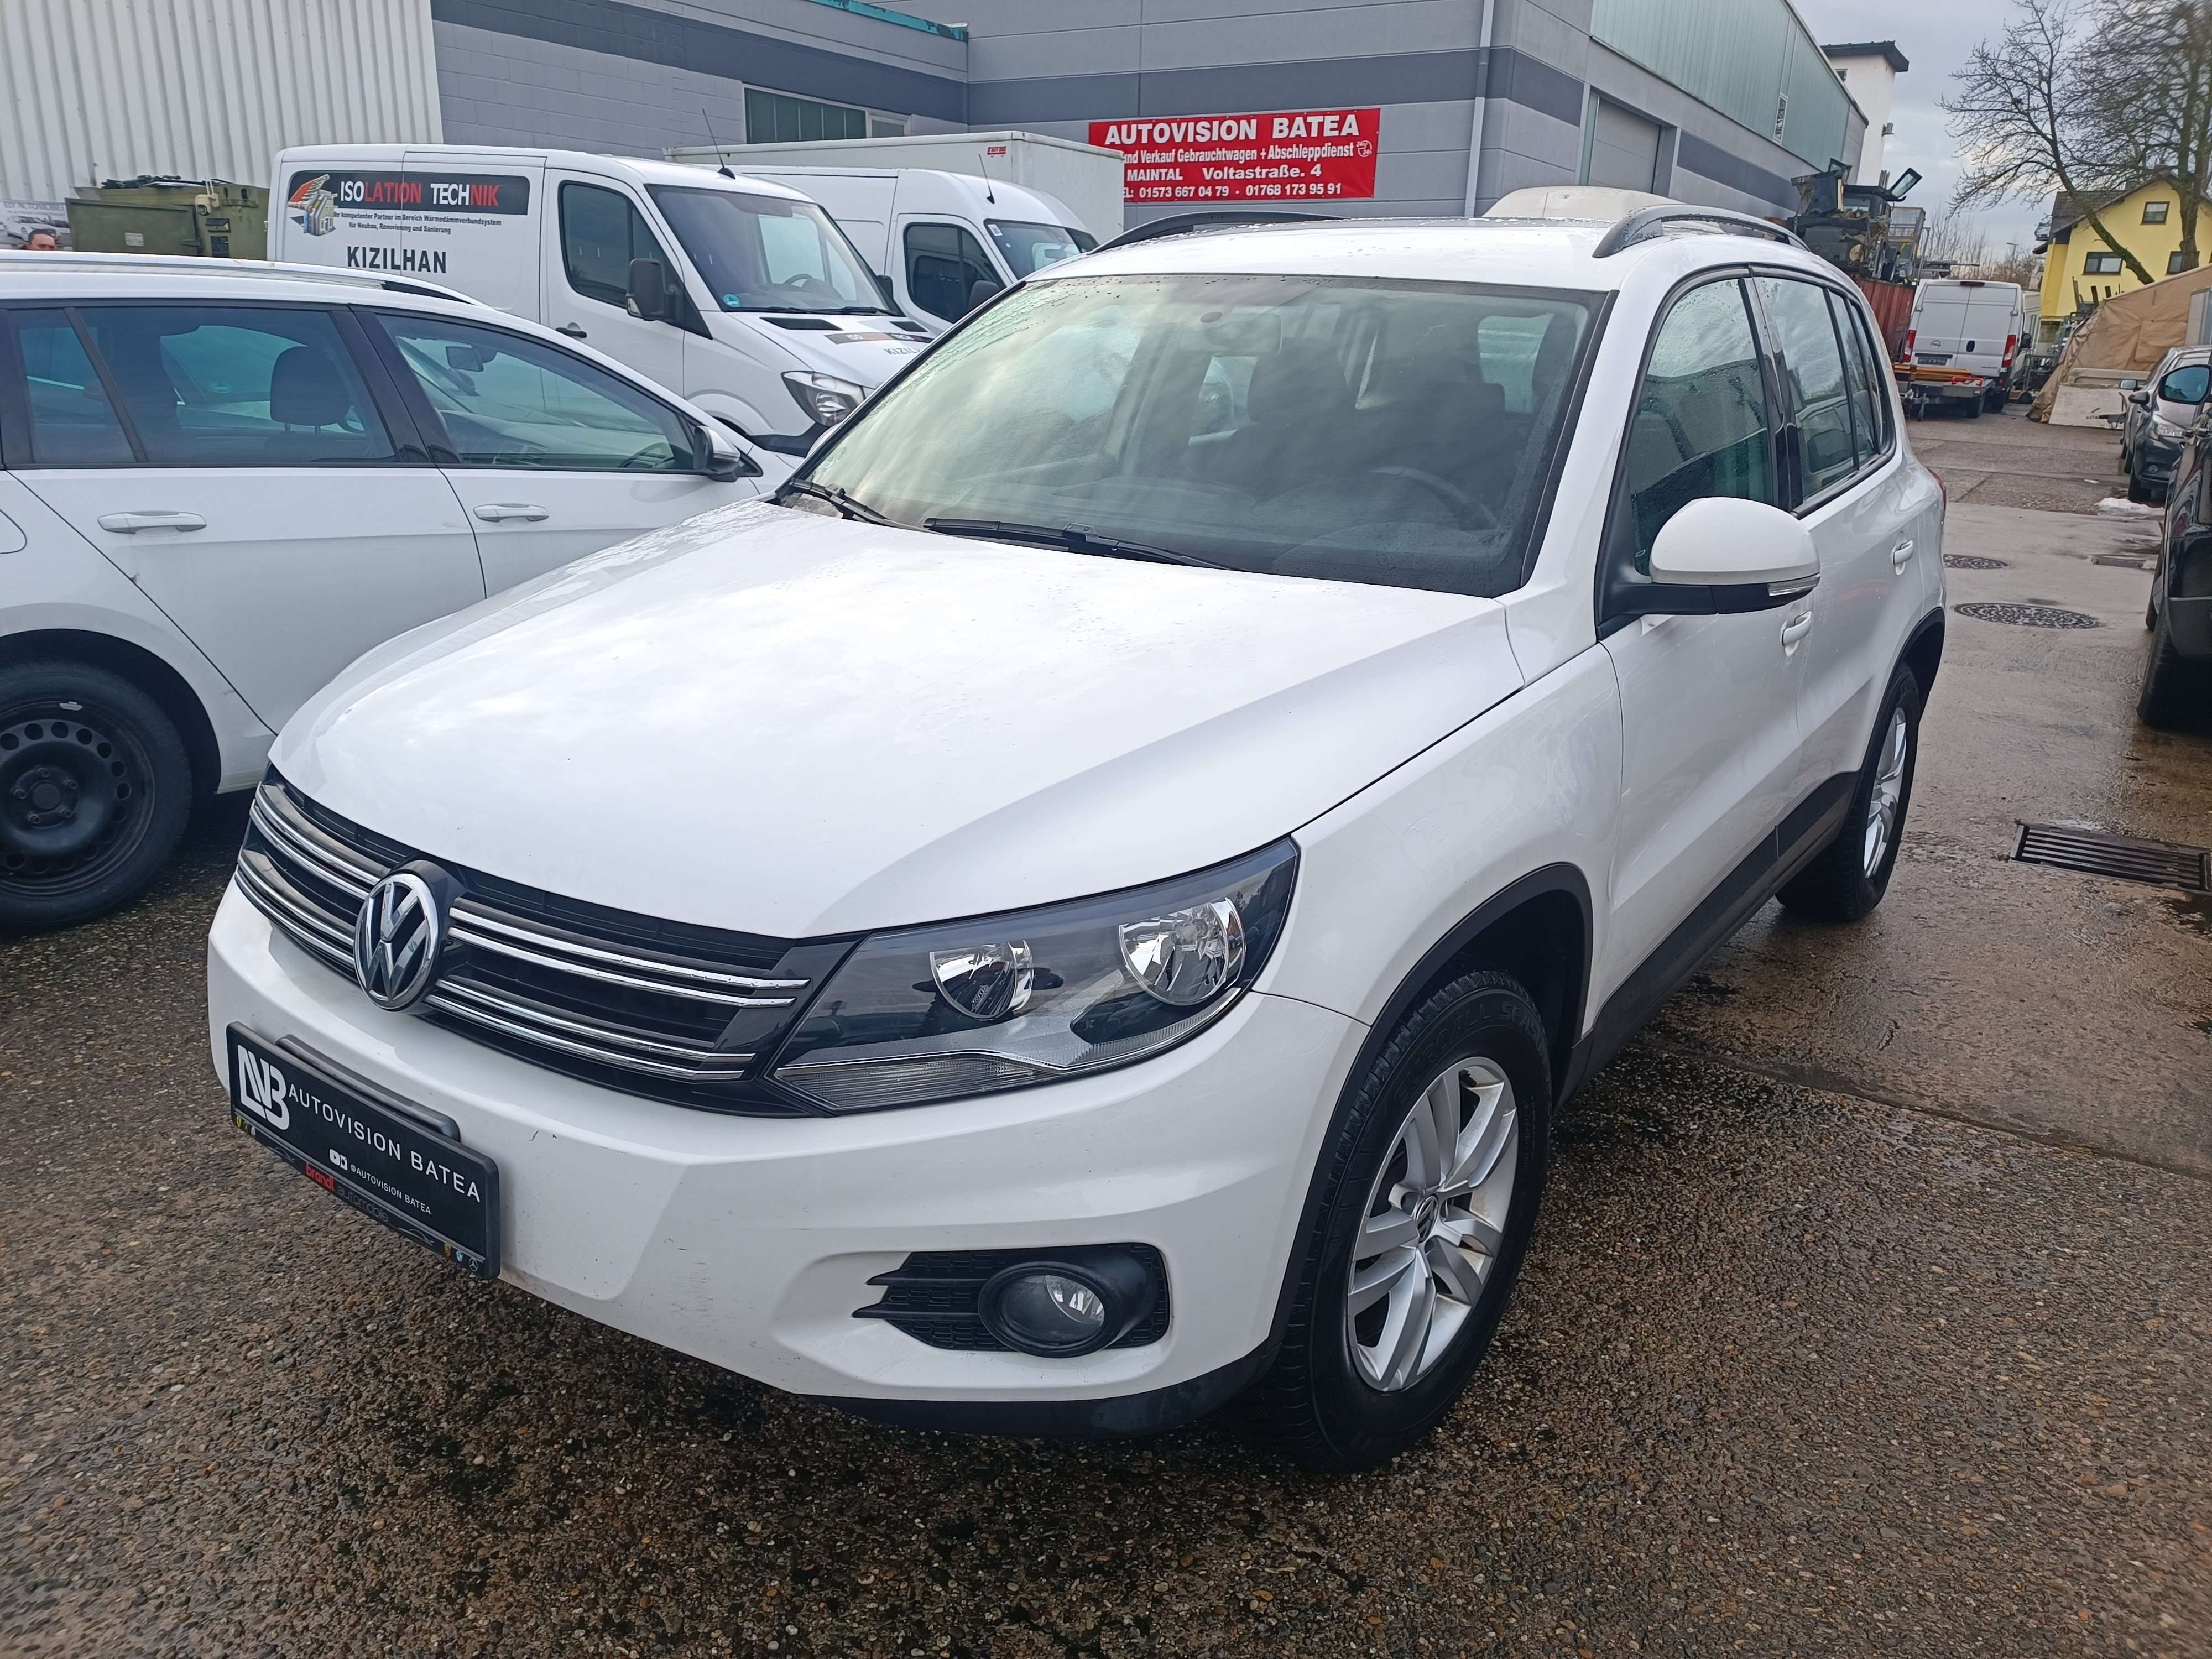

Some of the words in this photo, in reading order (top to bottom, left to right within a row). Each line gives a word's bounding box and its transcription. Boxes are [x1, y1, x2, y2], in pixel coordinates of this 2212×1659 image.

[1104, 119, 1257, 145] AUTOVISION
[1272, 114, 1359, 138] BATEA
[1140, 149, 1176, 164] Verkauf
[1177, 147, 1258, 164] Gebrauchtwagen
[1260, 148, 1266, 160] +
[1267, 142, 1354, 162] Abschleppdienst
[1126, 168, 1183, 181] MAINTAL
[1202, 164, 1305, 180] Voltastraße.
[1310, 164, 1322, 177] 4
[340, 181, 422, 204] ISOLATION
[430, 183, 500, 206] TECHNIK
[1139, 187, 1172, 198] 01573
[1175, 186, 1195, 197] 667
[1198, 186, 1212, 197] 04
[1215, 185, 1229, 197] 79
[1245, 184, 1281, 196] 01768
[1285, 183, 1306, 195] 173
[1309, 183, 1324, 195] 95
[1327, 182, 1341, 195] 91
[424, 226, 451, 235] Sanierung
[347, 246, 447, 273] KIZILHAN
[883, 347, 921, 356] KIZIL
[289, 1083, 401, 1161] AUTOVISION
[411, 1150, 481, 1203] BATEA
[350, 1164, 403, 1200] @AUTOVISION
[405, 1194, 431, 1216] BATEA
